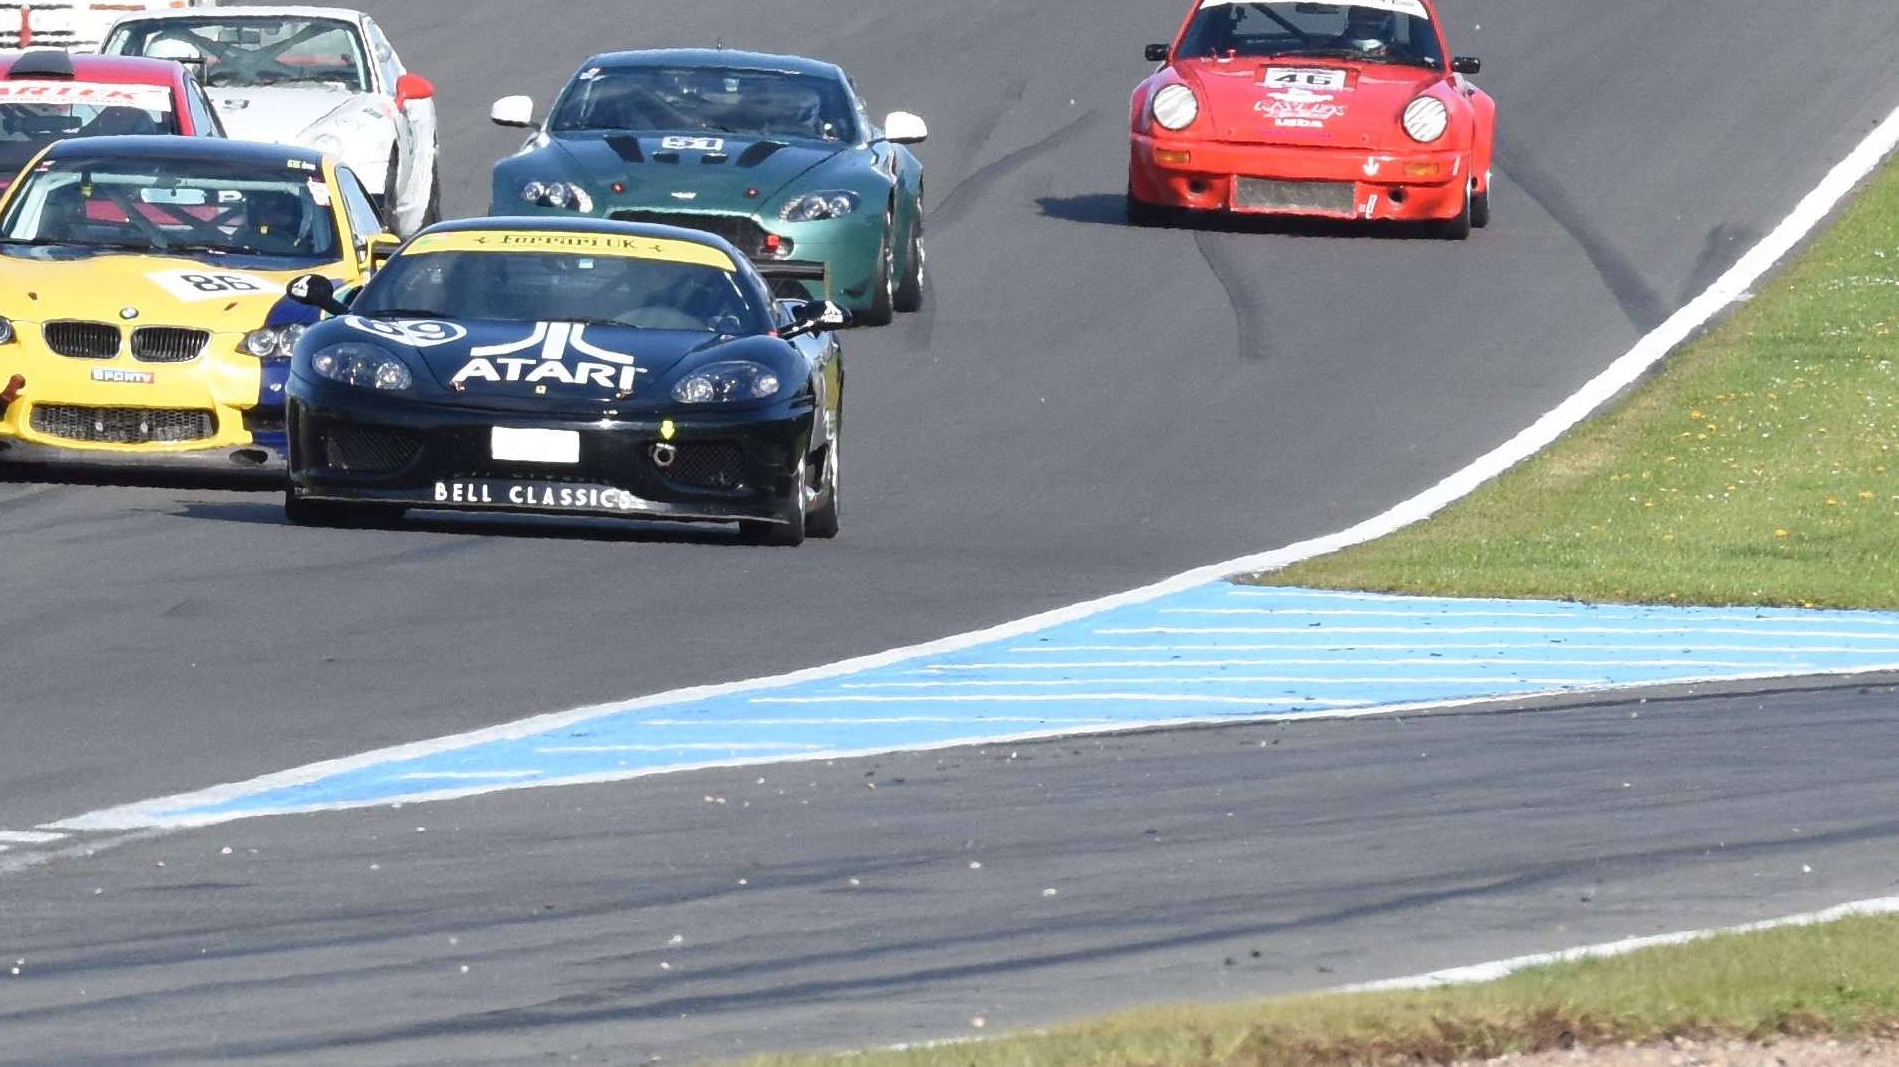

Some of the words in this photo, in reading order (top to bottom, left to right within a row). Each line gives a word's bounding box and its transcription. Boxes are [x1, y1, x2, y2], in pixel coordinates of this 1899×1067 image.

[500, 235, 598, 247] Ferrari
[606, 238, 637, 249] UK
[180, 274, 261, 292] 86
[451, 358, 635, 390] ATARI
[435, 483, 492, 503] BELL
[509, 485, 631, 510] CLASSICS
